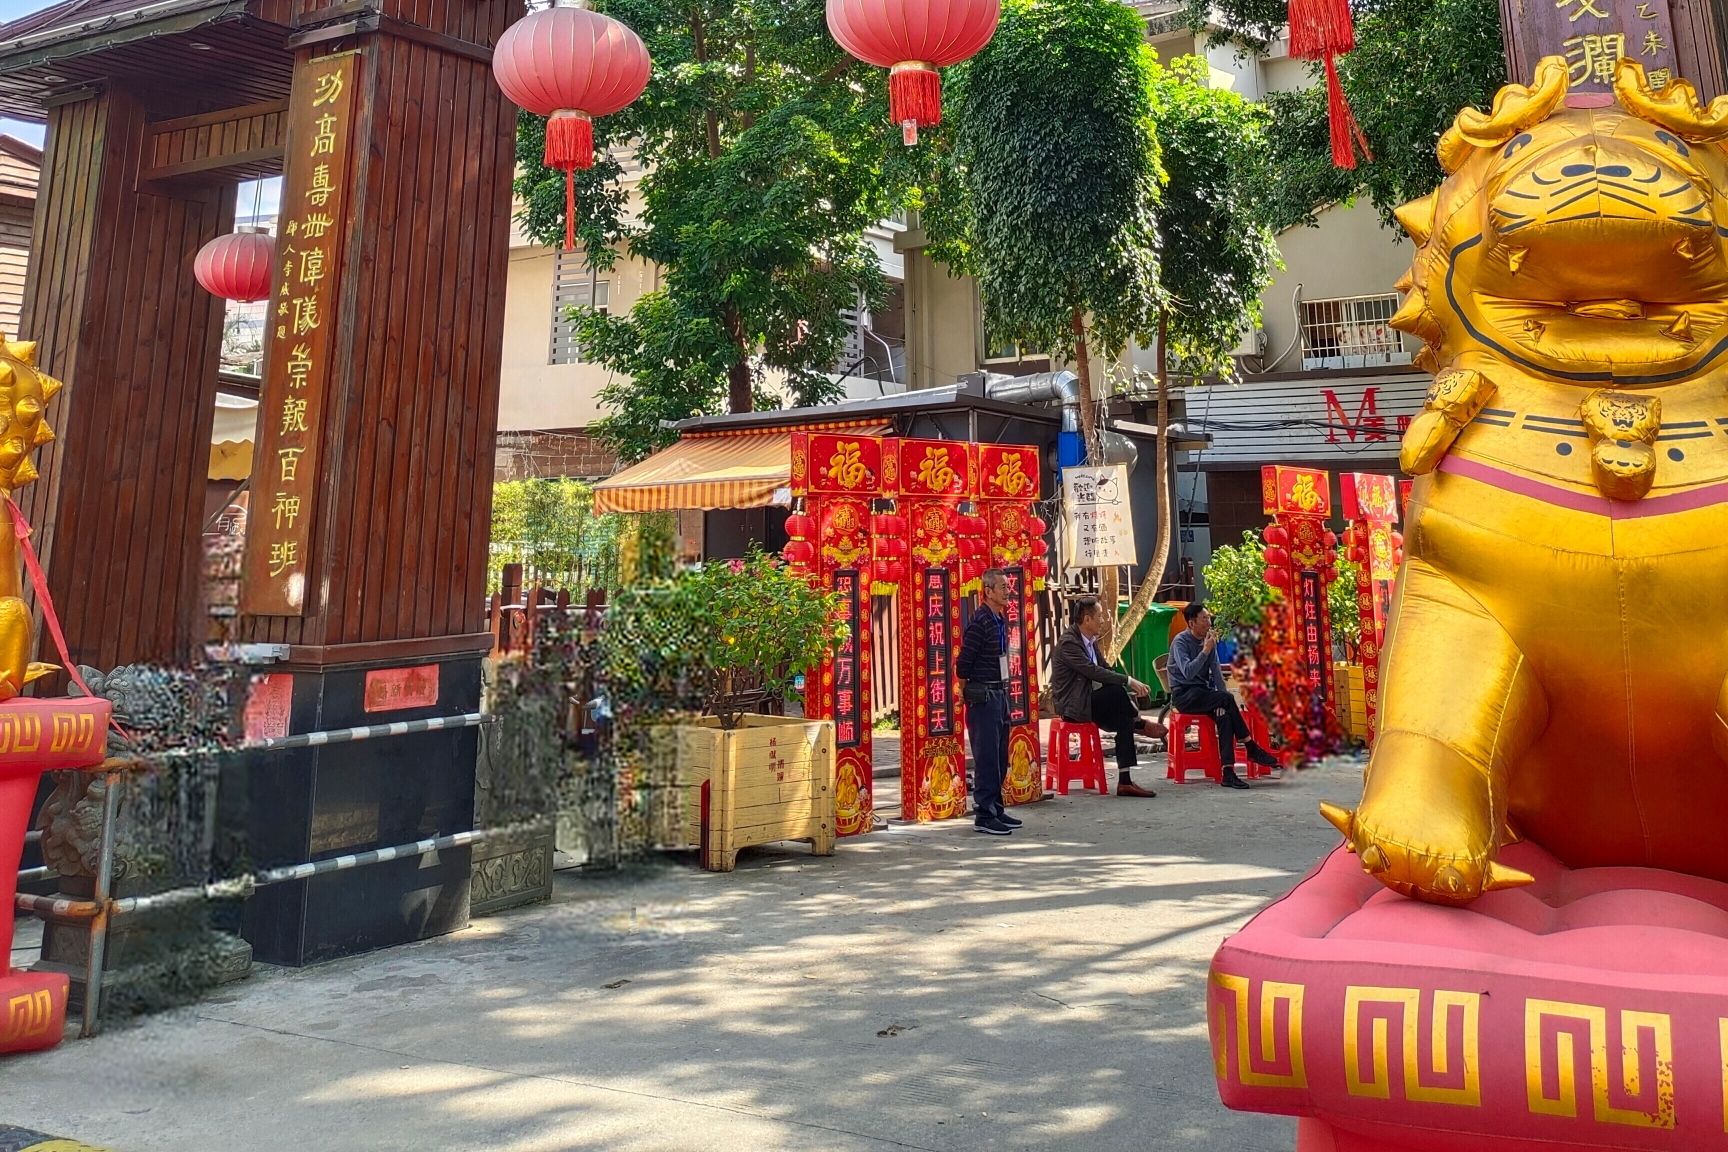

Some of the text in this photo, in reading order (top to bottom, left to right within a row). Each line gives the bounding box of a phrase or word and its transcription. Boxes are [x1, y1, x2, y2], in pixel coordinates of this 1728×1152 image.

[828, 441, 866, 489] 福
[918, 446, 953, 492] 福
[995, 451, 1027, 495] 福
[1292, 474, 1321, 510] 福
